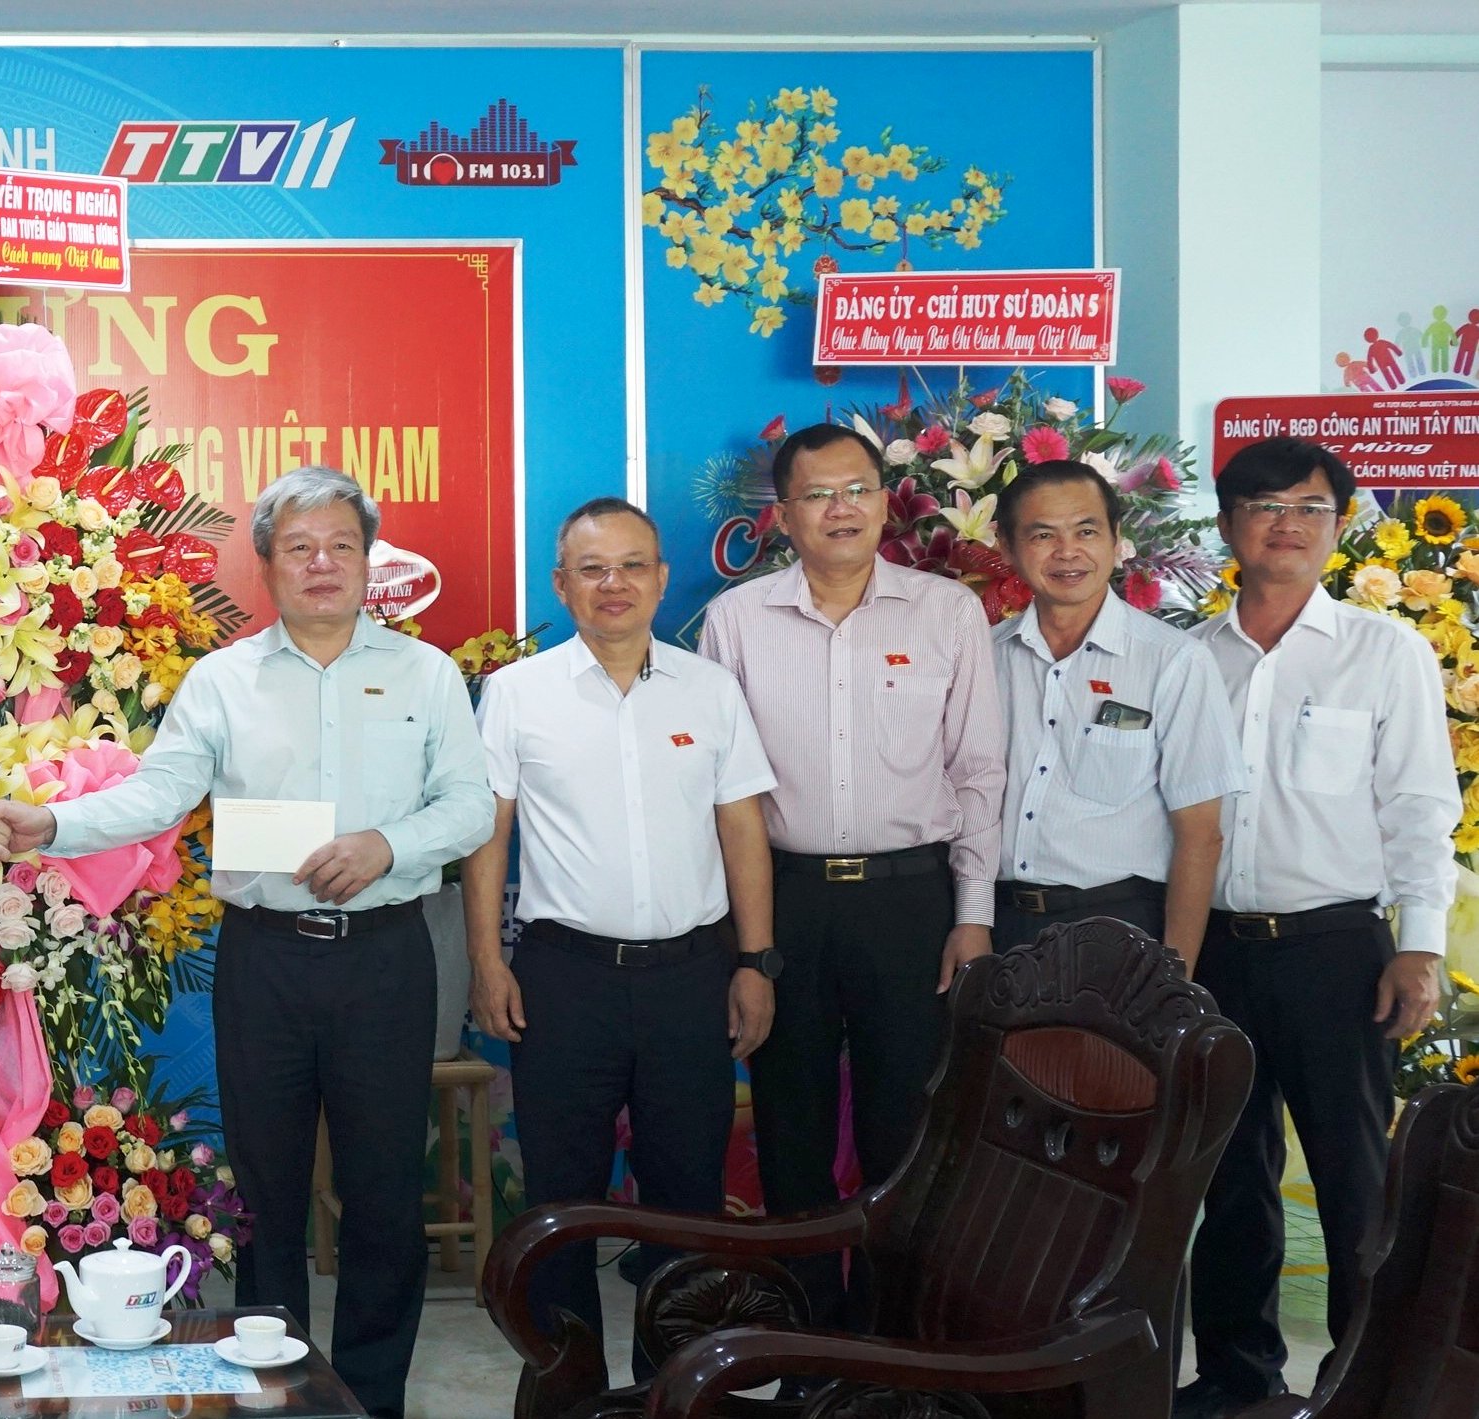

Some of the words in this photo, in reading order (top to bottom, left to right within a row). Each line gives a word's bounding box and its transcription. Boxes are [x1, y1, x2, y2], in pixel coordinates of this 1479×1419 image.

[469, 164, 493, 179] FM
[501, 164, 544, 179] 103.1
[26, 186, 73, 217] TRỌNG
[76, 188, 118, 217] NGHĨA
[0, 217, 18, 238] BAN
[20, 215, 44, 240] TUYÊN
[47, 218, 66, 242] GIÁO
[67, 223, 95, 244] TRUNG
[1, 242, 29, 265] Cách
[31, 247, 63, 271] mạng
[64, 245, 89, 272] Việt
[91, 249, 120, 271] Nam
[834, 286, 886, 320] ĐẢNG
[889, 285, 917, 320] ỦY
[927, 285, 958, 319] CHỈ
[961, 294, 996, 319] HUY
[1003, 287, 1029, 318] SƯ
[1030, 286, 1085, 318] ĐOÀN
[1088, 293, 1099, 317] 5
[831, 325, 857, 351] Chúc
[857, 326, 890, 355] Mừng
[892, 326, 924, 355] Ngày
[927, 325, 949, 350] Báo
[952, 324, 972, 350] Chí
[973, 324, 1001, 350] Cách
[1001, 324, 1035, 356] Mạng
[1039, 324, 1065, 356] Việt
[1067, 324, 1097, 350] Nam
[1223, 413, 1259, 437] ĐẢNG
[1290, 418, 1317, 437] BGĐ
[1321, 411, 1359, 436] CÔNG
[1362, 416, 1381, 436] AN
[1384, 411, 1419, 435] TỈNH
[1423, 410, 1451, 435] TÂY
[1454, 416, 1479, 434] NIN
[1349, 441, 1434, 455] Mừng
[342, 427, 439, 502] NAM
[1354, 460, 1385, 478] CÁCH
[1389, 464, 1425, 480] MẠNG
[1428, 460, 1456, 480] VIỆT
[1460, 465, 1479, 478] NA
